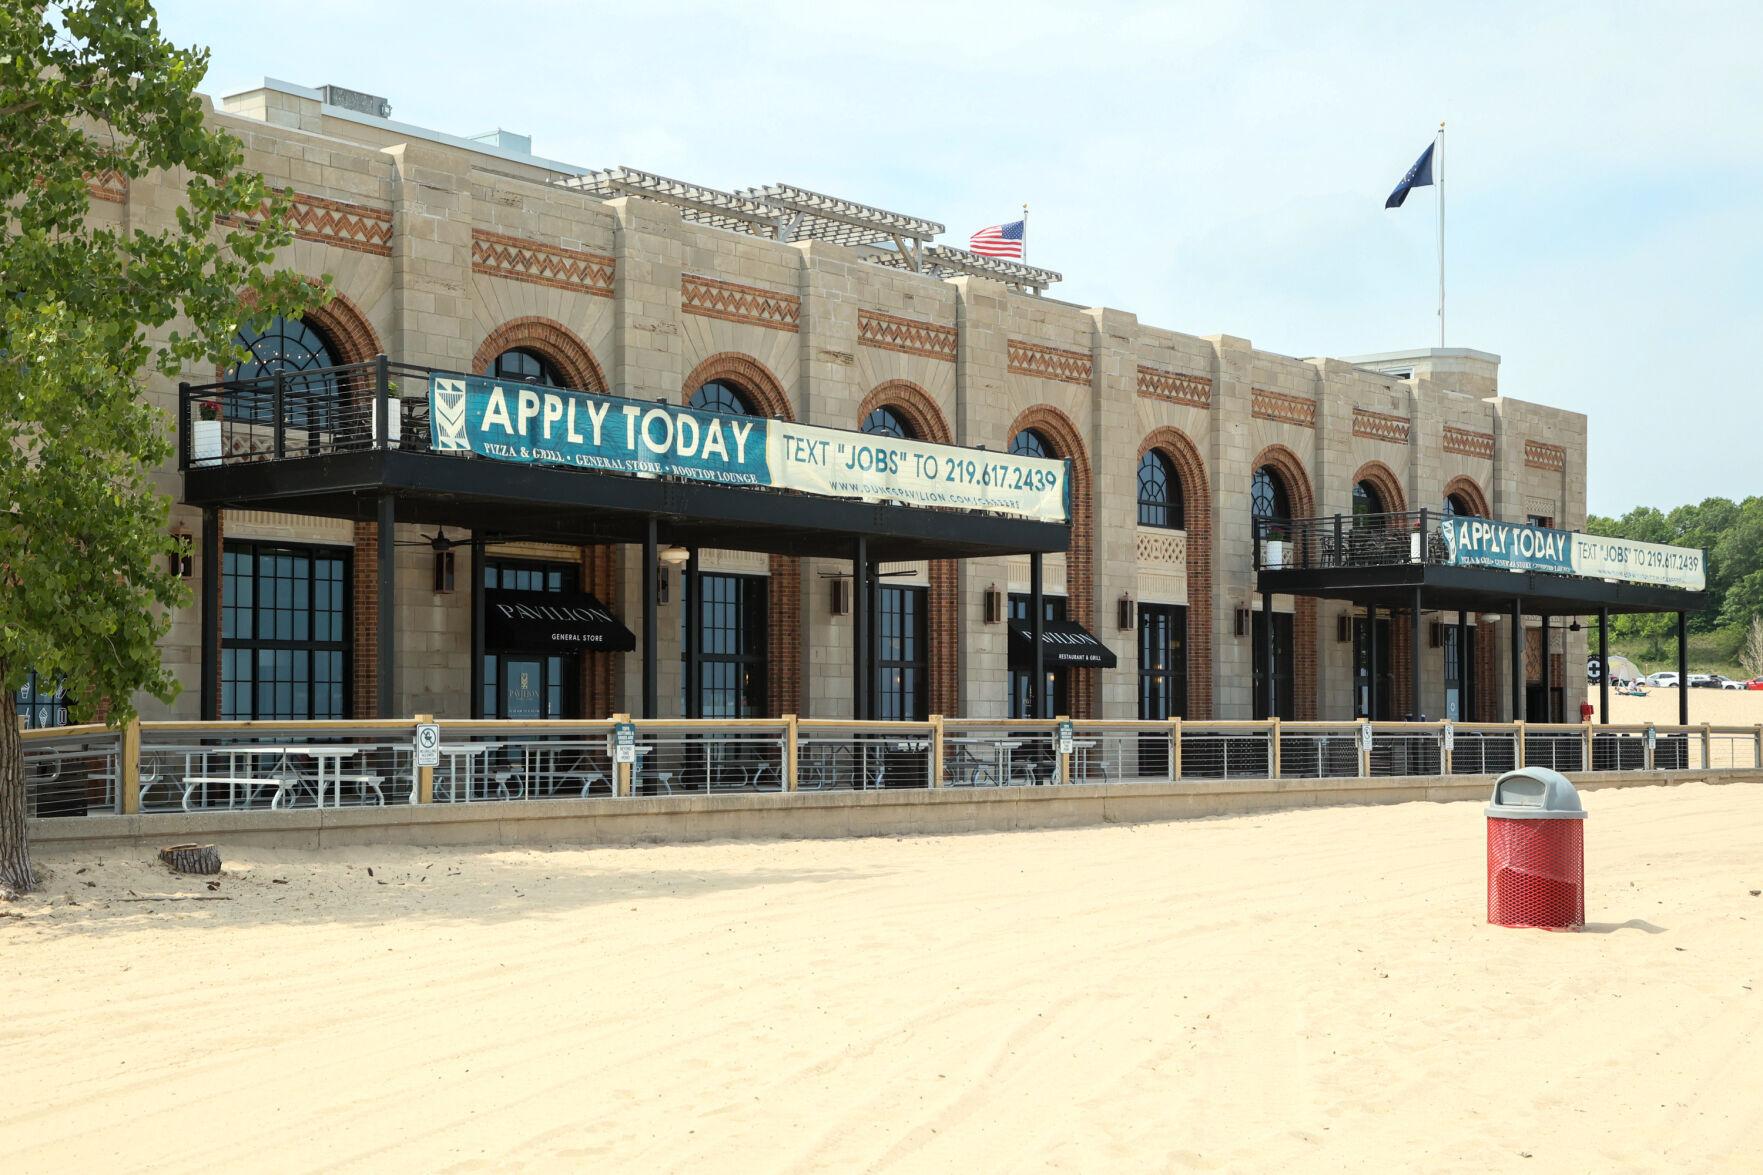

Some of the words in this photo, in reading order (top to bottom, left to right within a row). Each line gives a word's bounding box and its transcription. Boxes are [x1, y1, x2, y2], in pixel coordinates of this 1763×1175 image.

[481, 386, 610, 446] APPLY
[623, 405, 753, 464] TODAY
[483, 442, 517, 457] PIZZA
[520, 447, 529, 458] &
[533, 448, 565, 462] GRILL
[576, 454, 625, 470] GENERAL
[627, 459, 662, 473] STORE
[672, 465, 715, 481] ROOFTOP
[717, 471, 757, 485] LOUNGE
[783, 434, 830, 466] TEXT
[838, 444, 907, 476] "JOBS"
[914, 453, 938, 480] TO
[945, 457, 1057, 493] 219.617.2439
[1459, 520, 1509, 554] APPLY
[1512, 528, 1566, 562] TODAY
[1578, 542, 1598, 560] TEXT
[1634, 549, 1646, 566] TO
[1647, 551, 1699, 572] 219.617.2439
[496, 602, 613, 623] PAVILION
[551, 633, 581, 641] GENERAL
[583, 634, 603, 642] STORE
